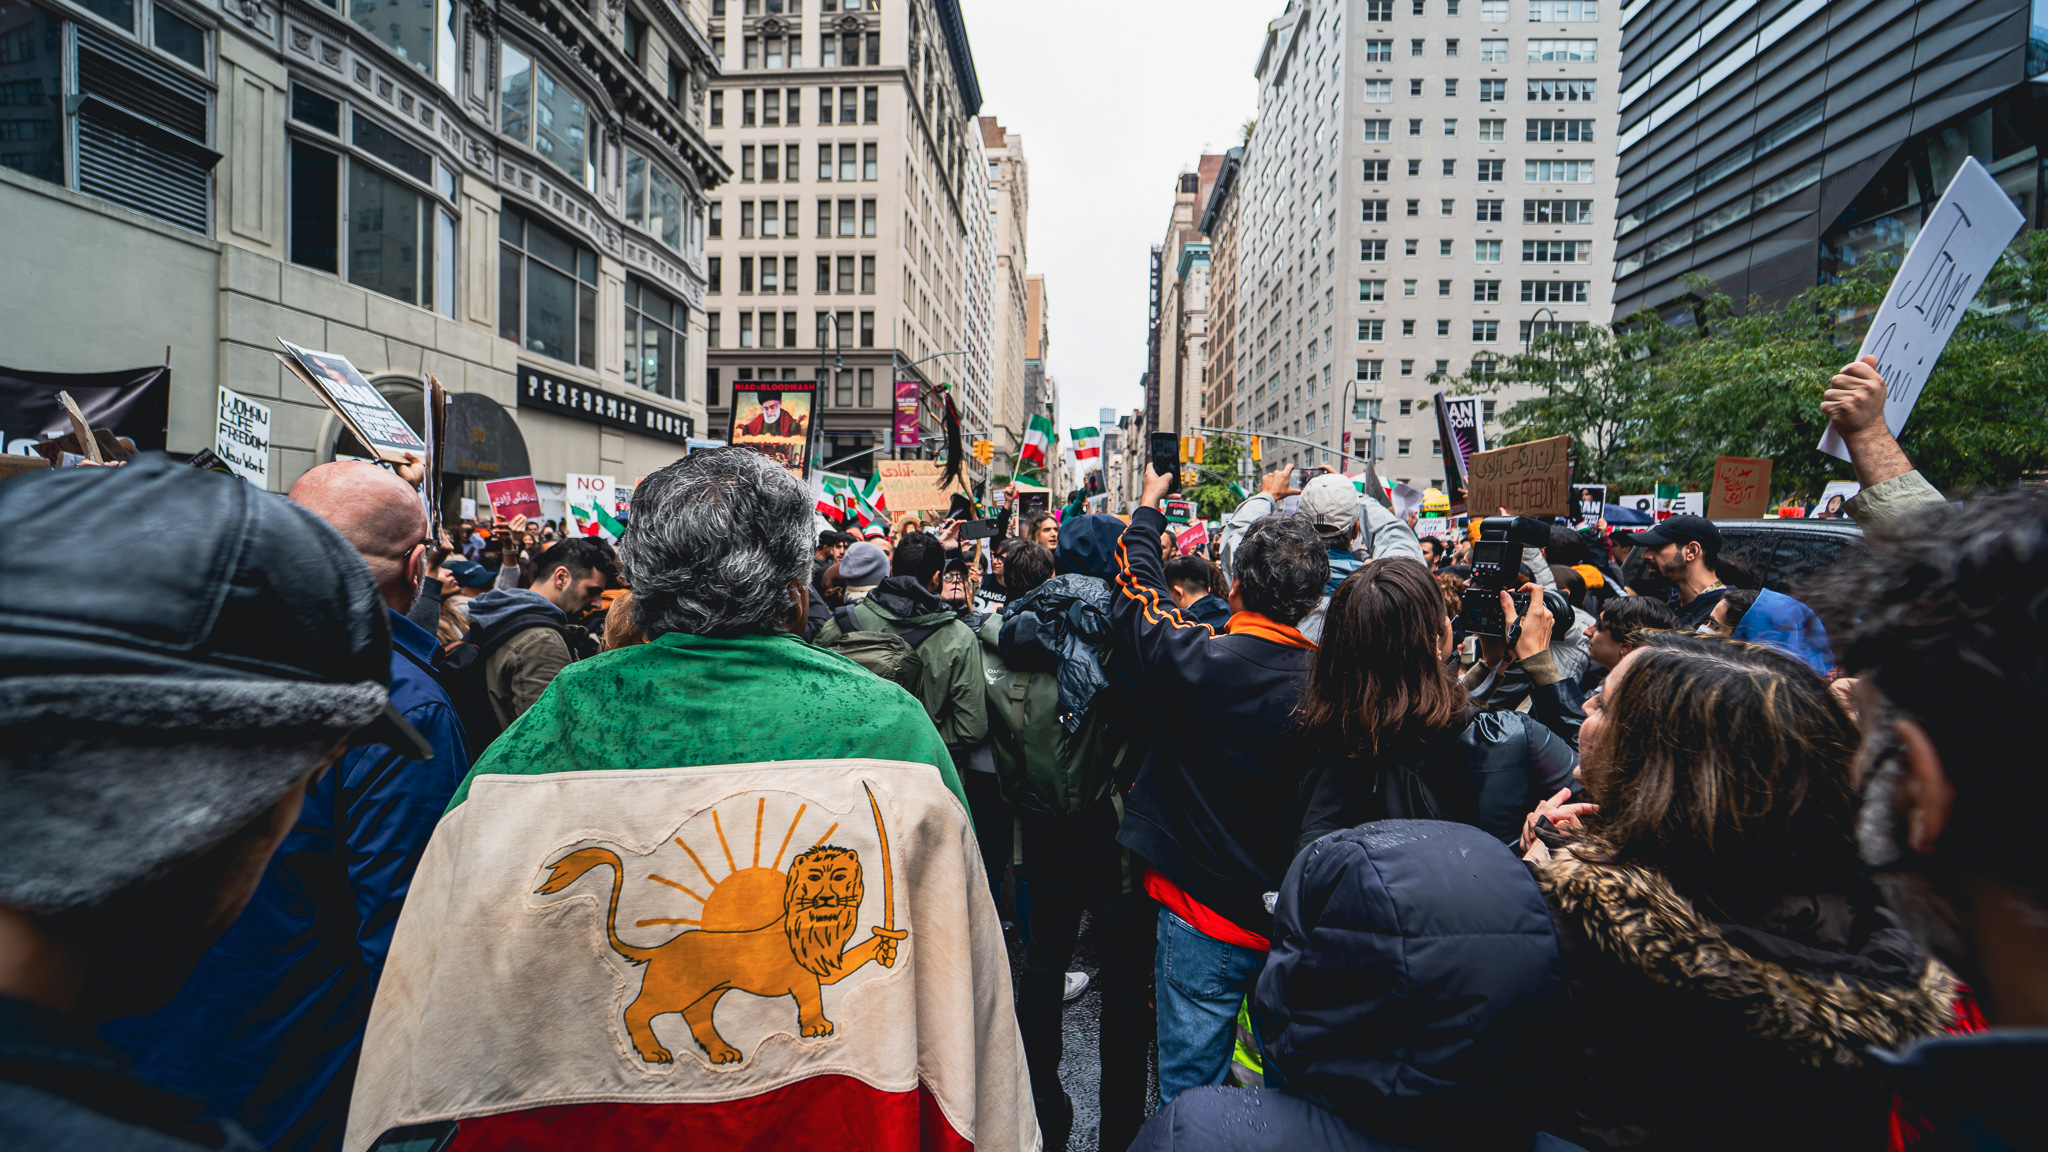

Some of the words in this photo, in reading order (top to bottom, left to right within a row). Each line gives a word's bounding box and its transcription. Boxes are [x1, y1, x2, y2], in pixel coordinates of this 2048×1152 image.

[316, 374, 386, 409] IRAN
[220, 406, 254, 434] LIFE
[221, 391, 267, 425] WOMAN
[219, 422, 268, 453] FREEDOM
[218, 444, 242, 465] New
[577, 477, 605, 491] NO
[979, 590, 1007, 602] MAHSA
